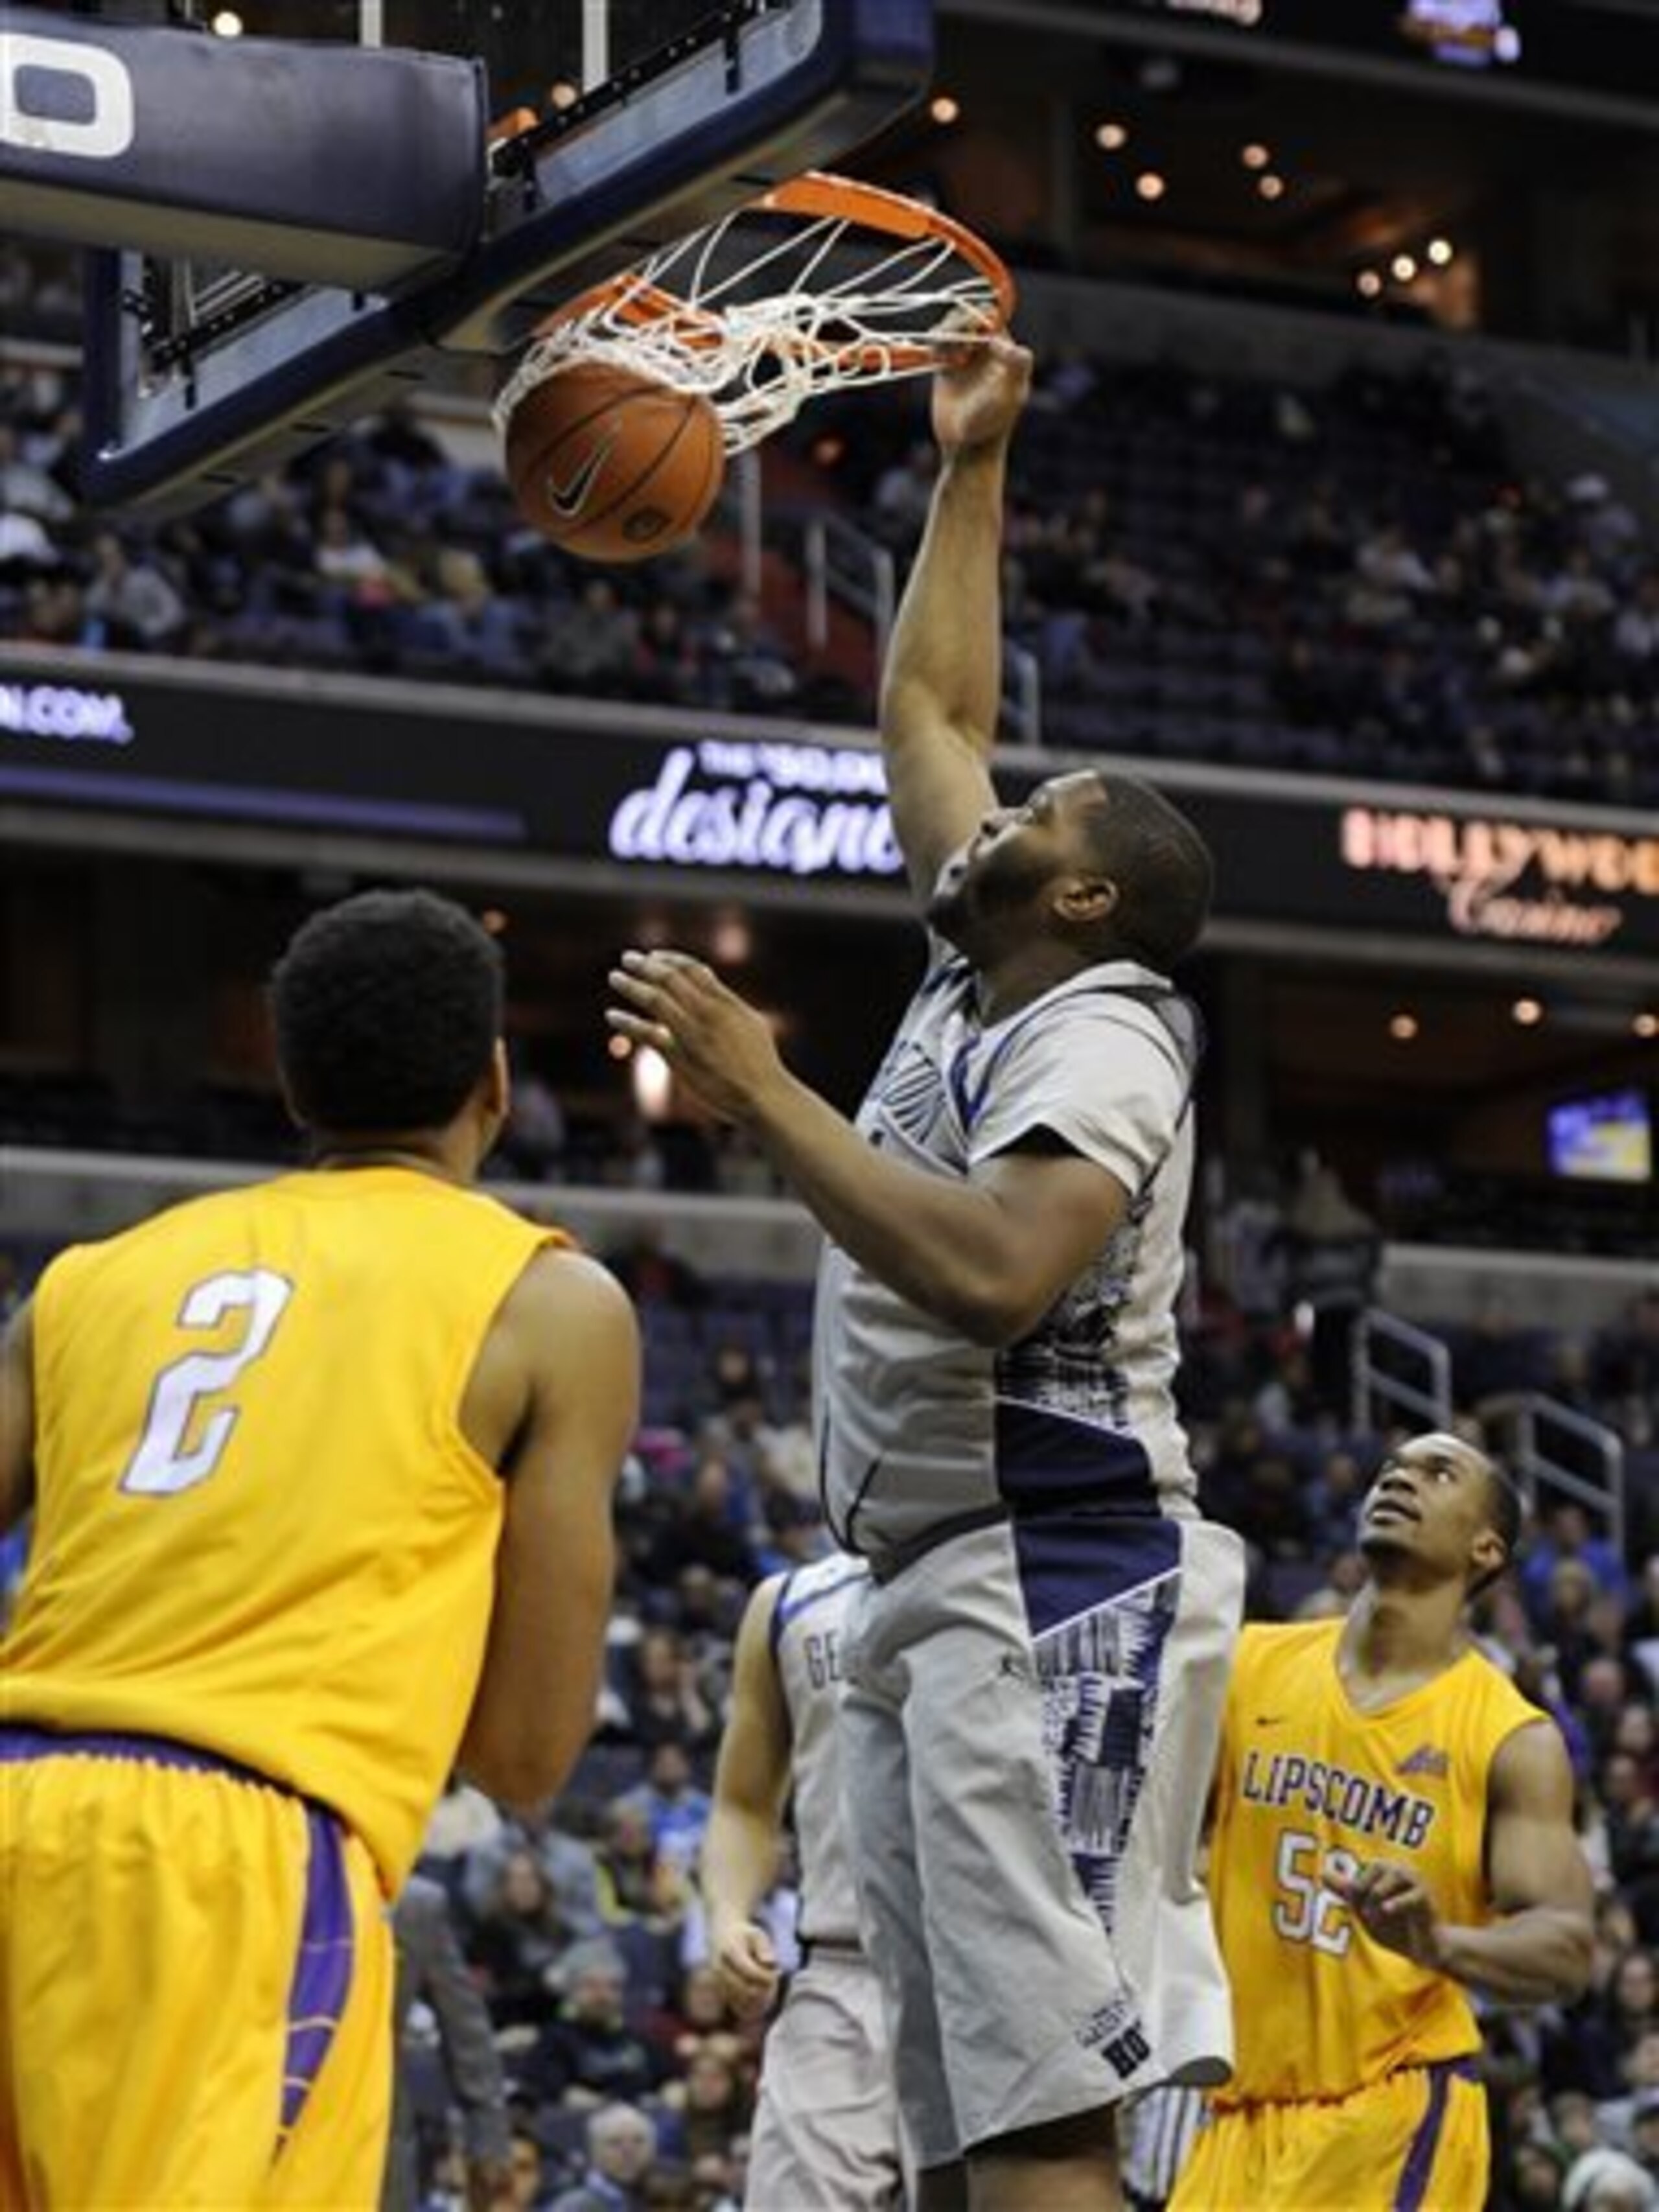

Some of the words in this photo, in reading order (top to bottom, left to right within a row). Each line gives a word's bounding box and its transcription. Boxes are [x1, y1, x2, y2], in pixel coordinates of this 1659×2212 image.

[117, 1264, 296, 1497] 2
[1241, 1748, 1436, 1851] LIPSCOMB
[1273, 1828, 1363, 1959] 52
